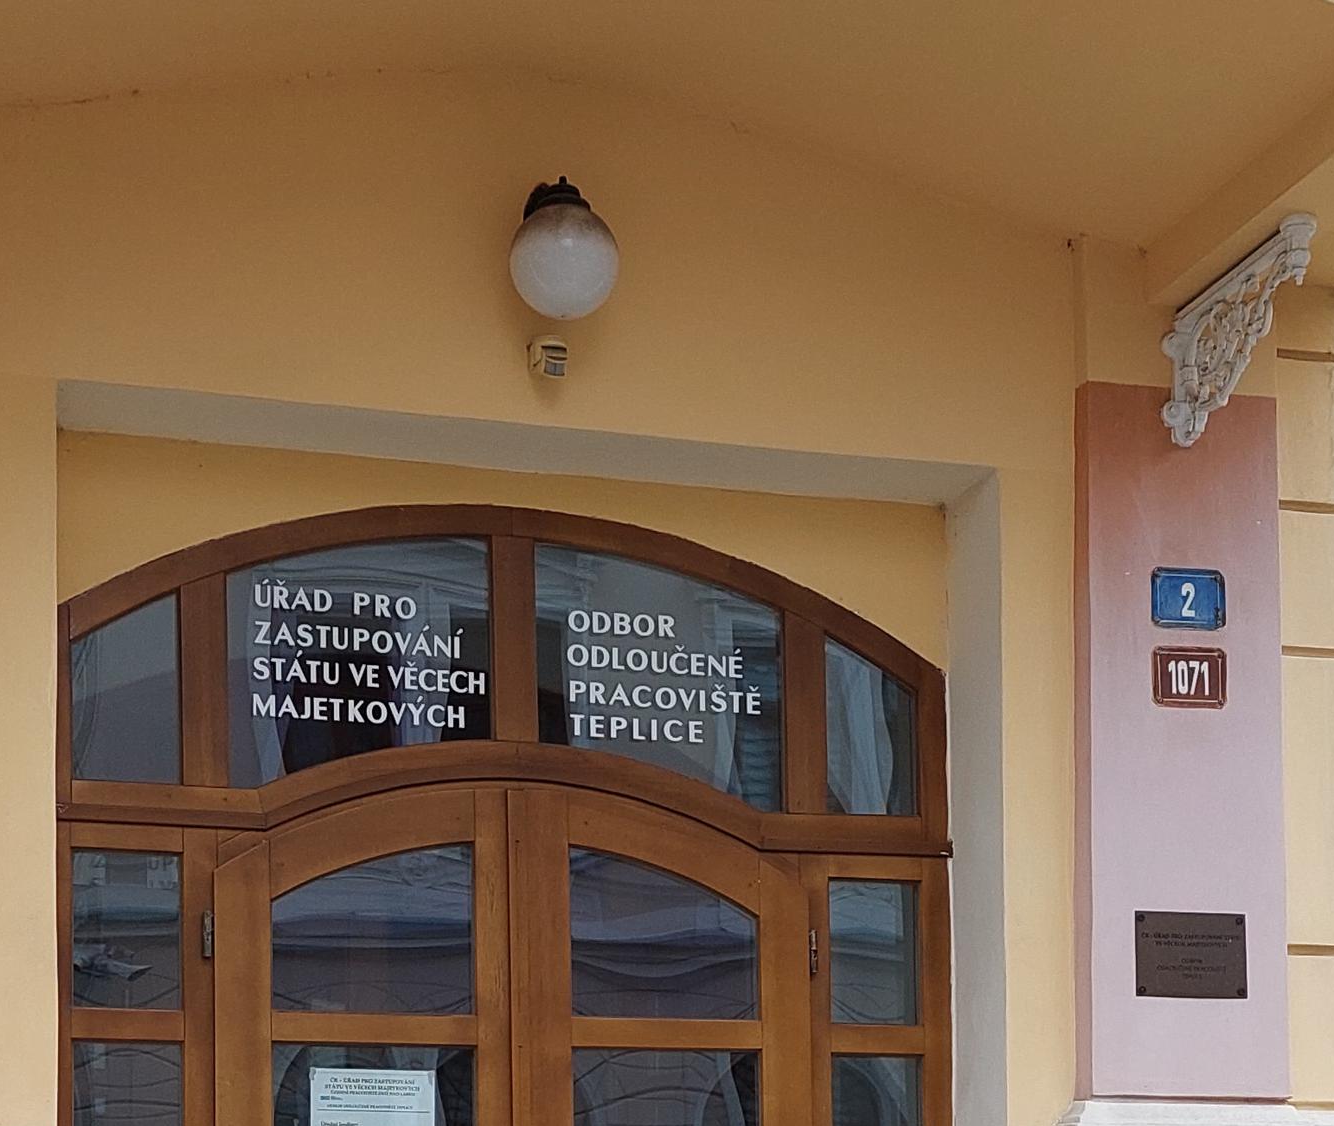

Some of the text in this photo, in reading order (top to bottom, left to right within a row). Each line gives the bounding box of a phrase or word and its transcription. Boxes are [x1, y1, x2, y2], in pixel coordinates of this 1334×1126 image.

[253, 578, 417, 620] ÚŘAD PRO
[1180, 582, 1196, 618] 2
[253, 620, 465, 659] ZASTUPOVÁNÍ
[568, 609, 676, 639] ODBOR
[252, 652, 487, 695] STÁTU VE VĚCECH
[567, 643, 744, 680] ODLOUČENÉ
[1167, 660, 1210, 697] 1071
[252, 693, 467, 730] MAJETKOVÝCH
[569, 679, 762, 716] PRACOVIŠTĚ
[570, 713, 705, 744] TEPLICE
